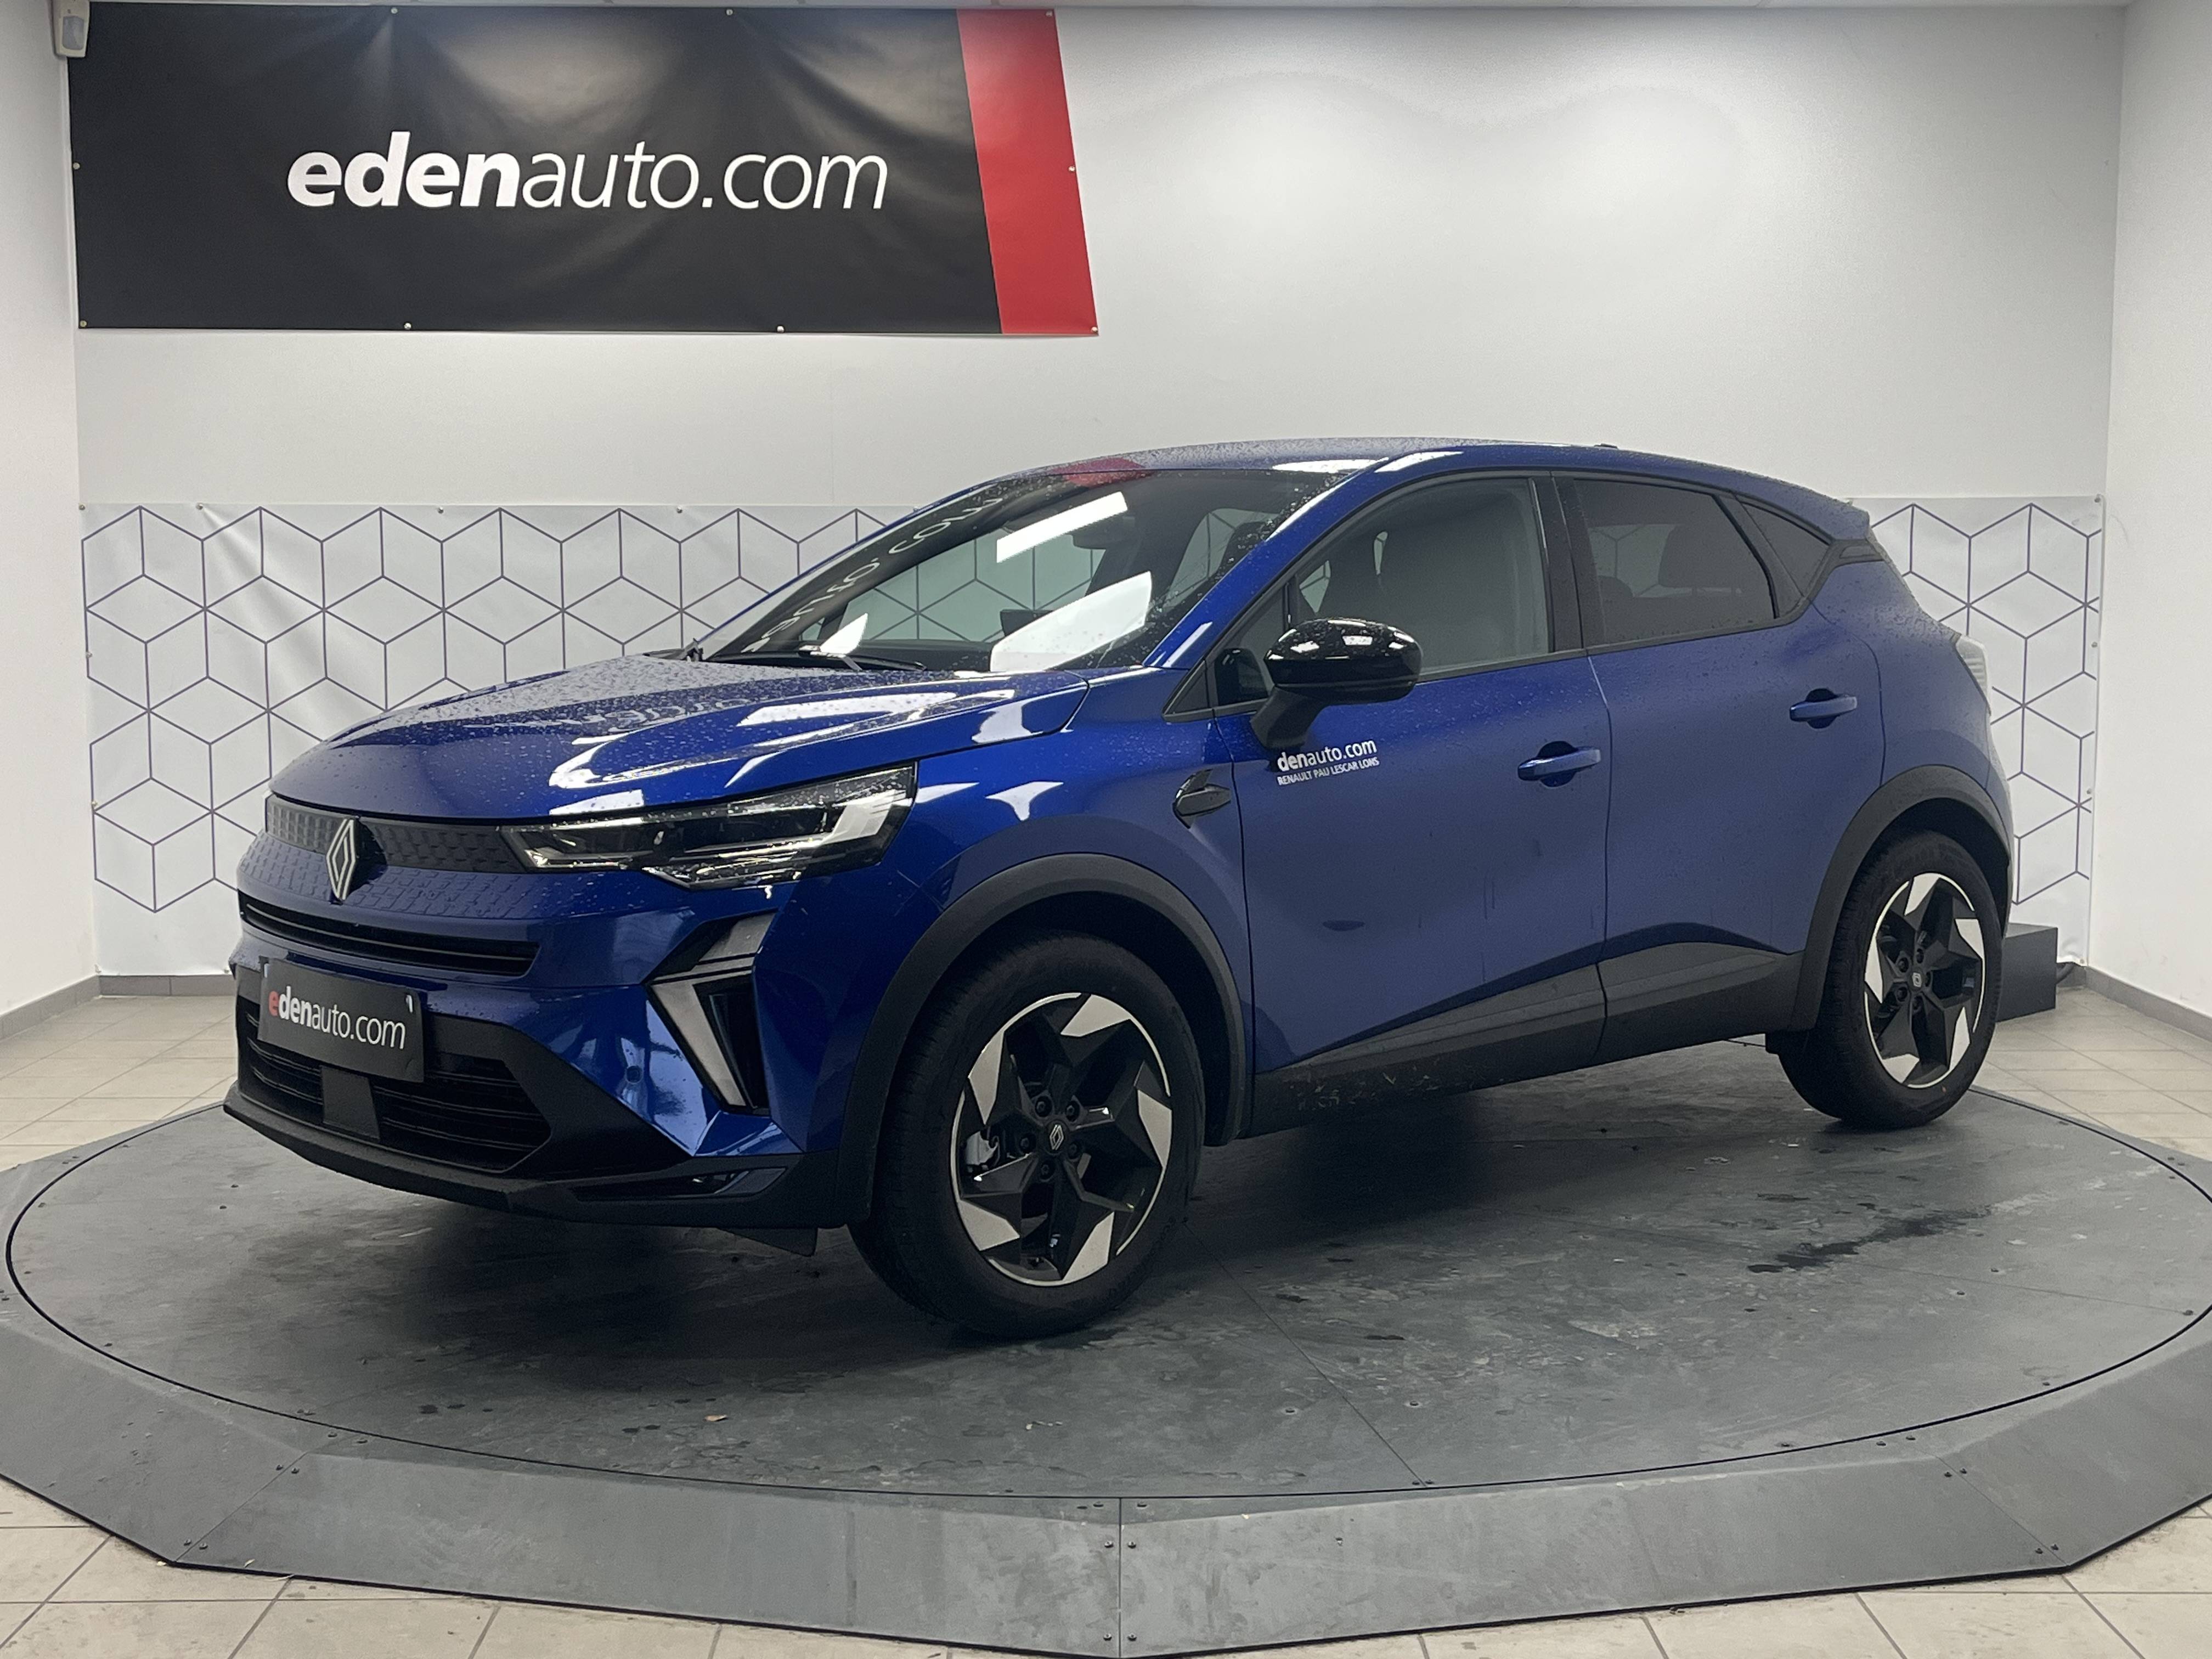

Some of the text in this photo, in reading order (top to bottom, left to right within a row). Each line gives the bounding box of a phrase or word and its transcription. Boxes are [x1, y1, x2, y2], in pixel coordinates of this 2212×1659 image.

[287, 131, 888, 210] edenauto.com
[1277, 770, 1313, 786] RENAULT
[1313, 767, 1330, 778] PAU
[1330, 760, 1358, 775] LESCAR
[268, 986, 406, 1049] edenauto.com
